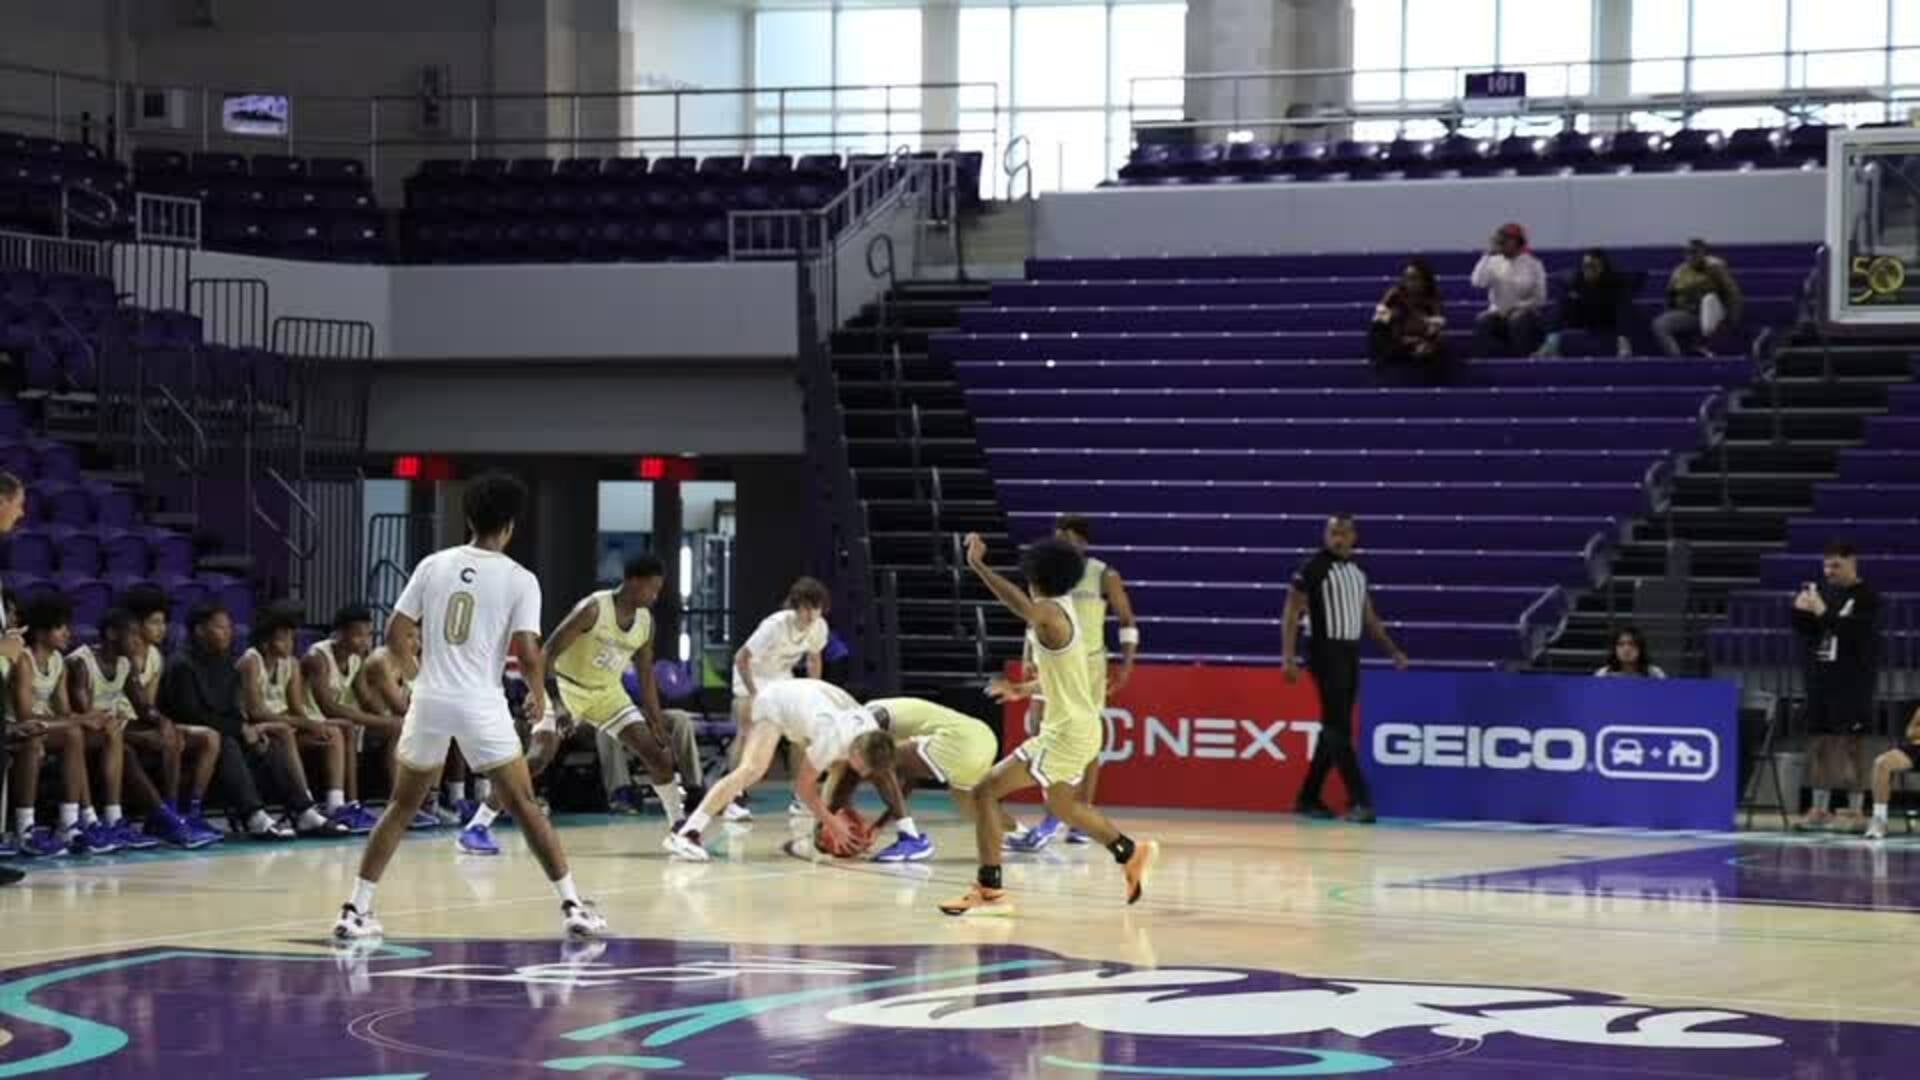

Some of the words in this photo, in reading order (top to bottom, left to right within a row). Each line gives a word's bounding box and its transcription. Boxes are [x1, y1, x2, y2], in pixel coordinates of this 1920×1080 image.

[1488, 75, 1516, 93] 101
[444, 591, 474, 645] 0
[1144, 717, 1323, 762] NEXT
[1373, 723, 1587, 771] GEICO
